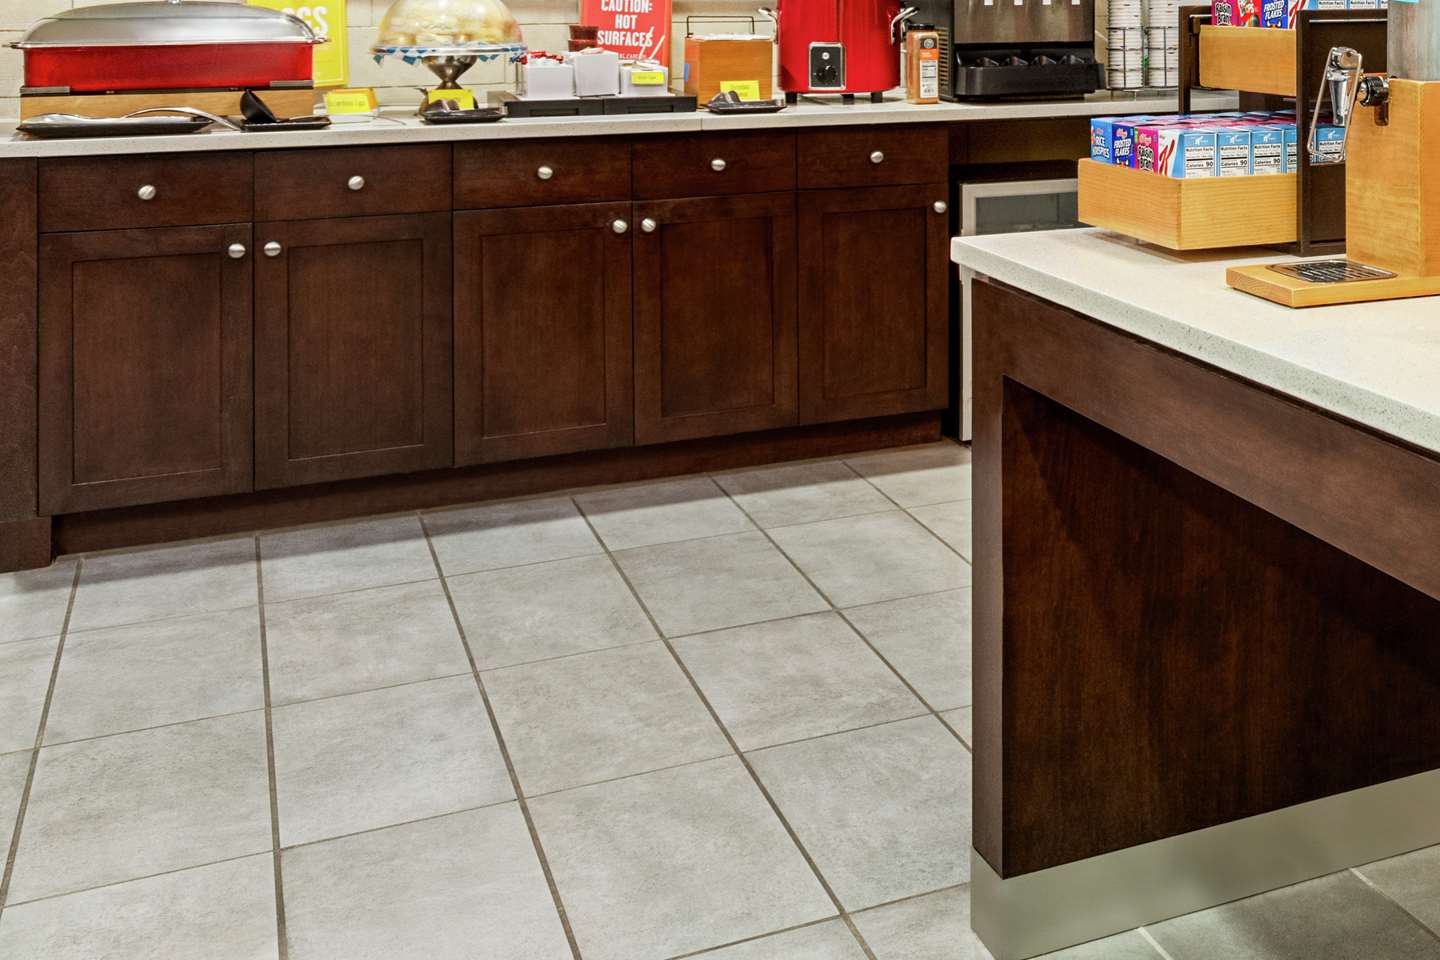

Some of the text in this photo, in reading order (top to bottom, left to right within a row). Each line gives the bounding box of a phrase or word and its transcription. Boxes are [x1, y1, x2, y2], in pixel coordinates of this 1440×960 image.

[1264, 0, 1285, 13] FROSTED
[1264, 9, 1283, 20] FLAKES
[615, 14, 638, 30] HOT
[596, 30, 654, 47] SURFACES
[1114, 138, 1132, 149] FROSTED
[1114, 147, 1130, 158] FLAKES
